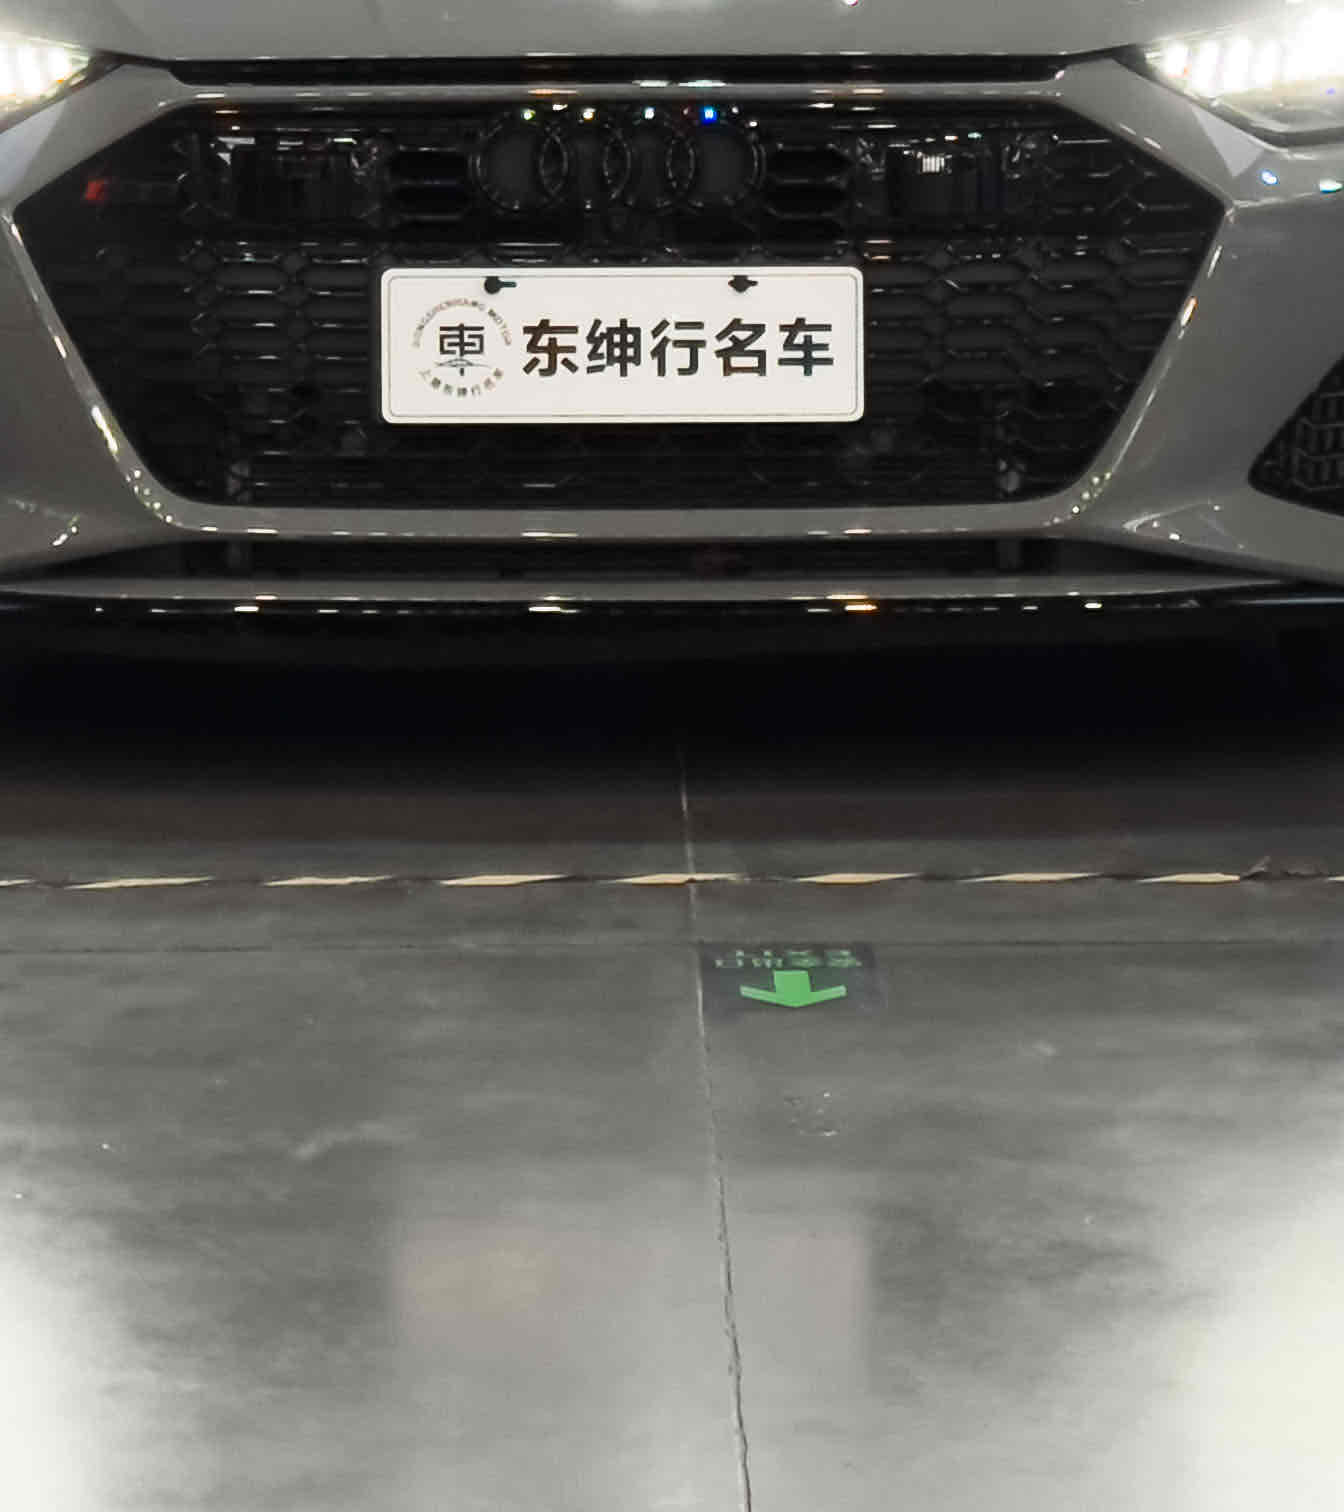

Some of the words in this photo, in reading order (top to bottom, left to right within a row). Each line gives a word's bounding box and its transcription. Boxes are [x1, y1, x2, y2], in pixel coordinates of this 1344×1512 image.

[522, 317, 834, 377] 东绅行名车
